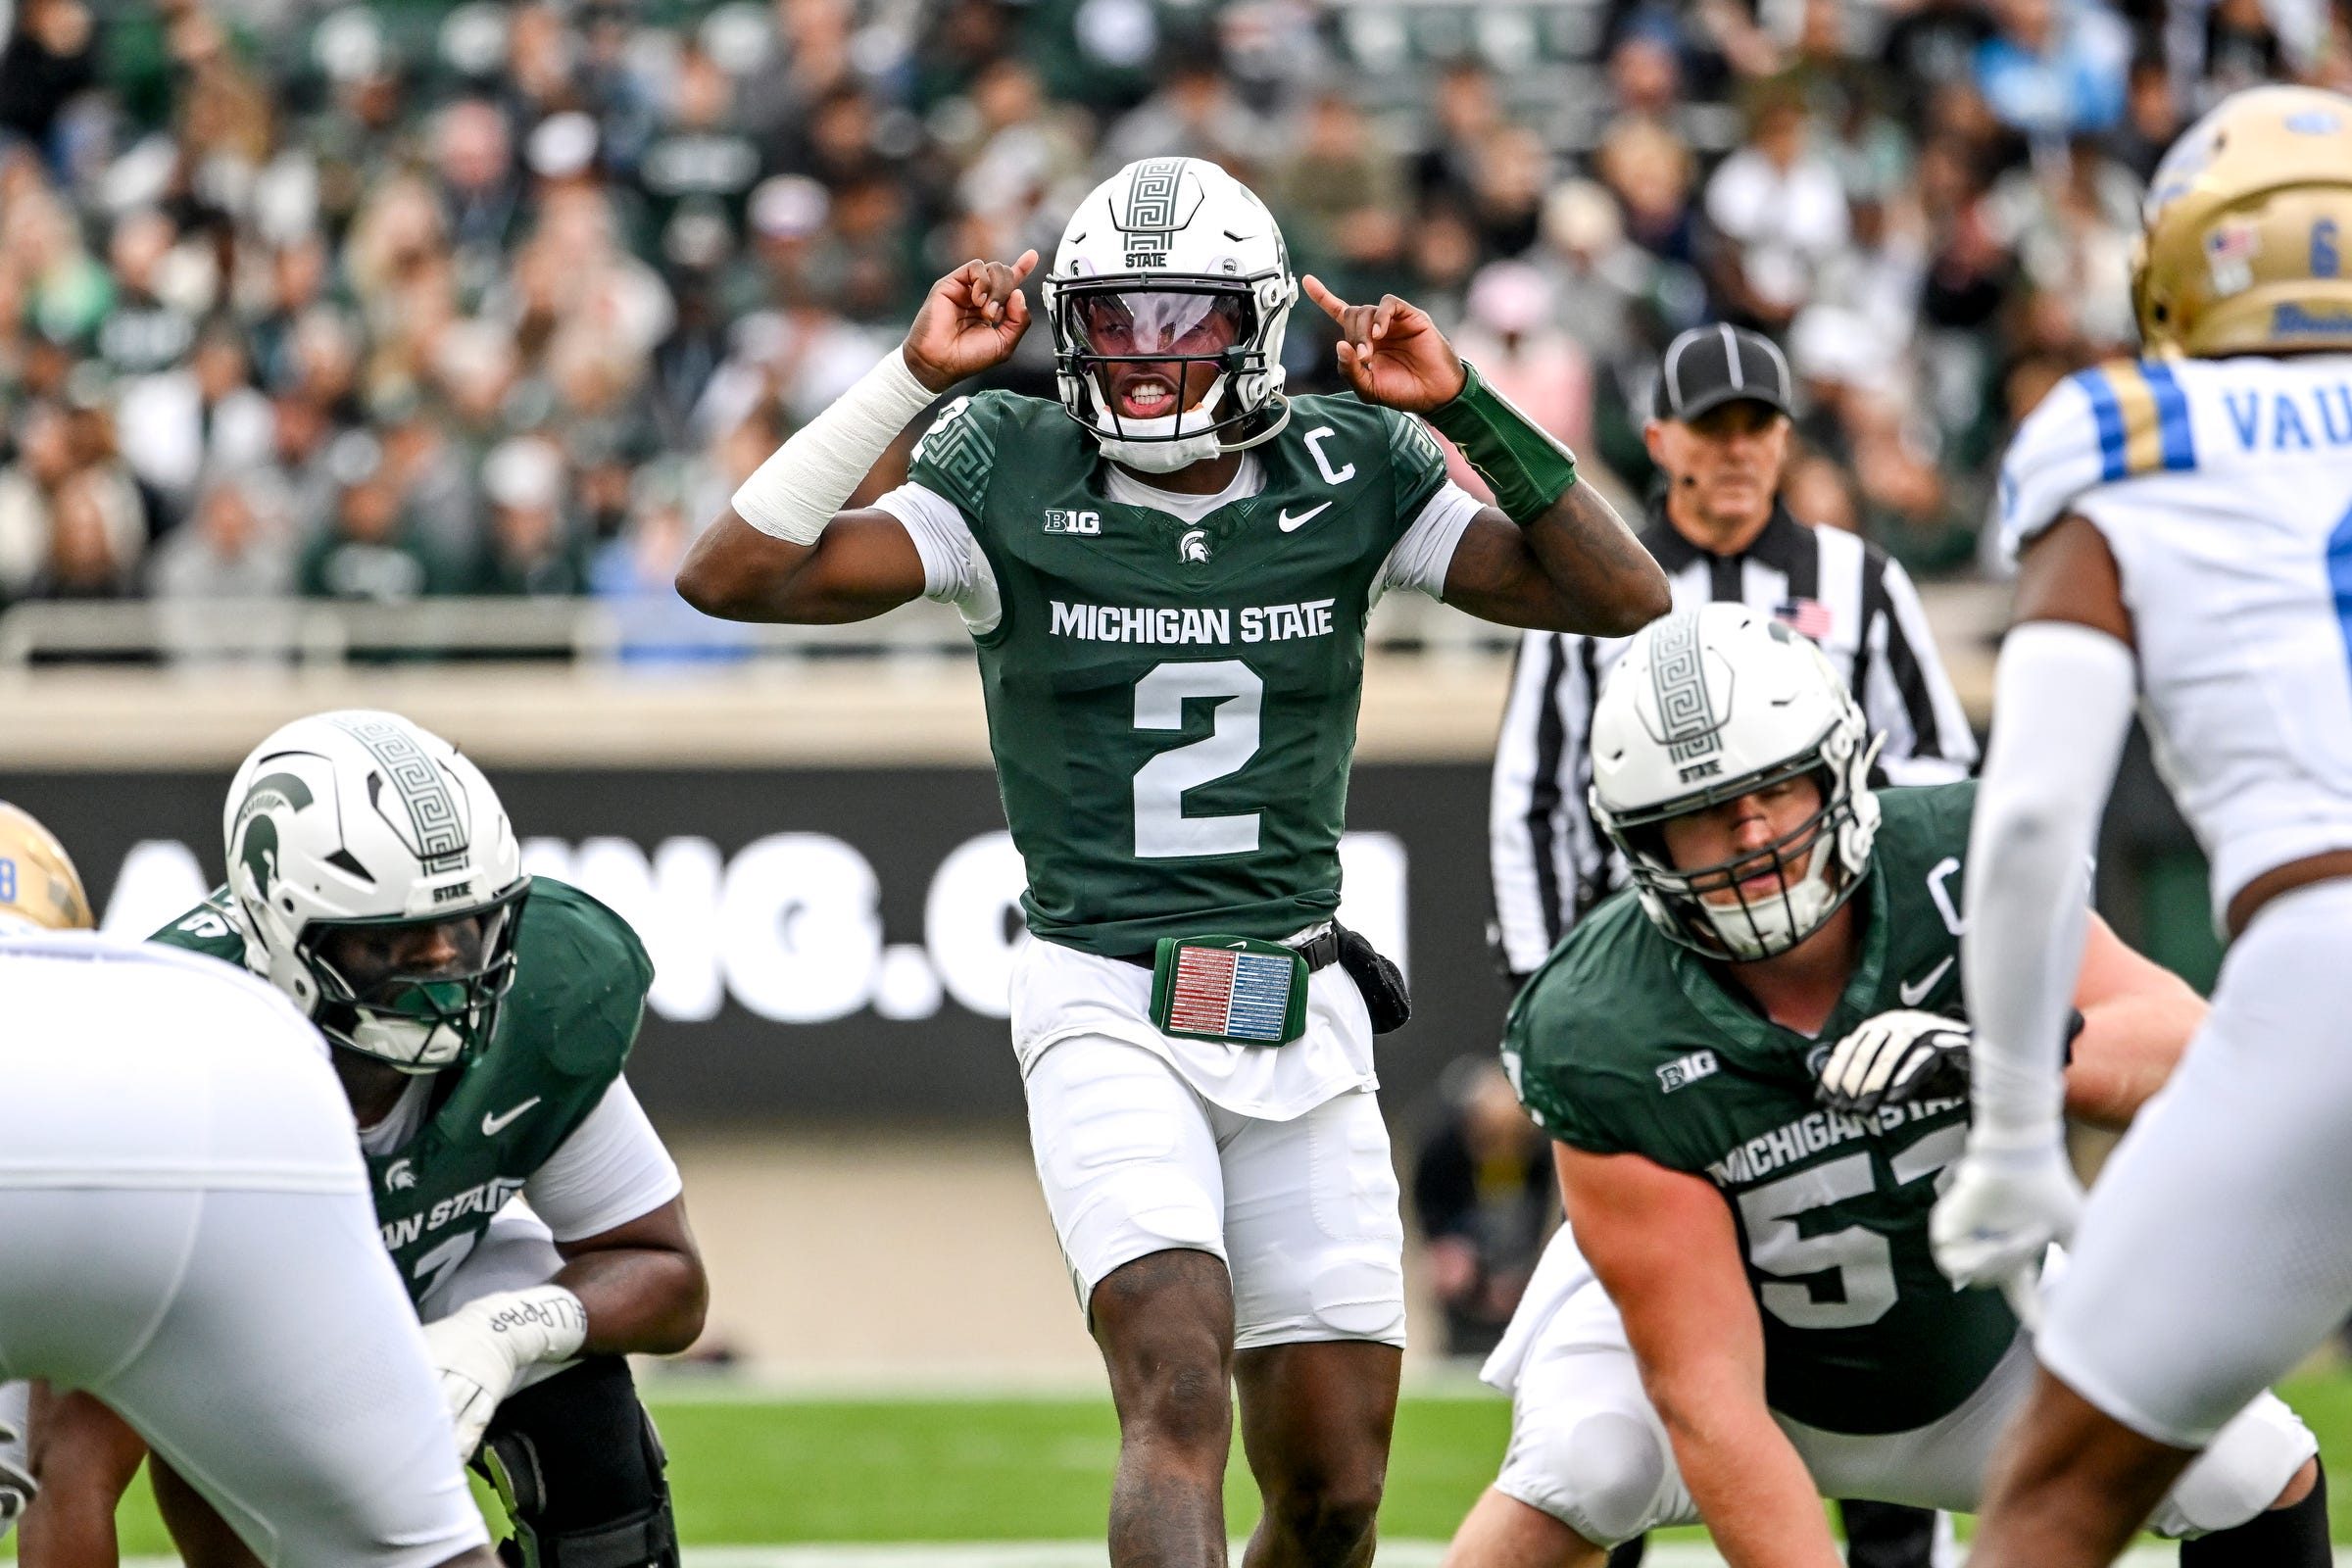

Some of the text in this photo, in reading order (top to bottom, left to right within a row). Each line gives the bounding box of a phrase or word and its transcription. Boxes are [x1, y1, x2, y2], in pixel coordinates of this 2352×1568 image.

[1125, 252, 1167, 268] STATE
[1303, 426, 1355, 484] C
[1049, 598, 1336, 644] MICHIGAN STATE
[1133, 660, 1263, 858] 2
